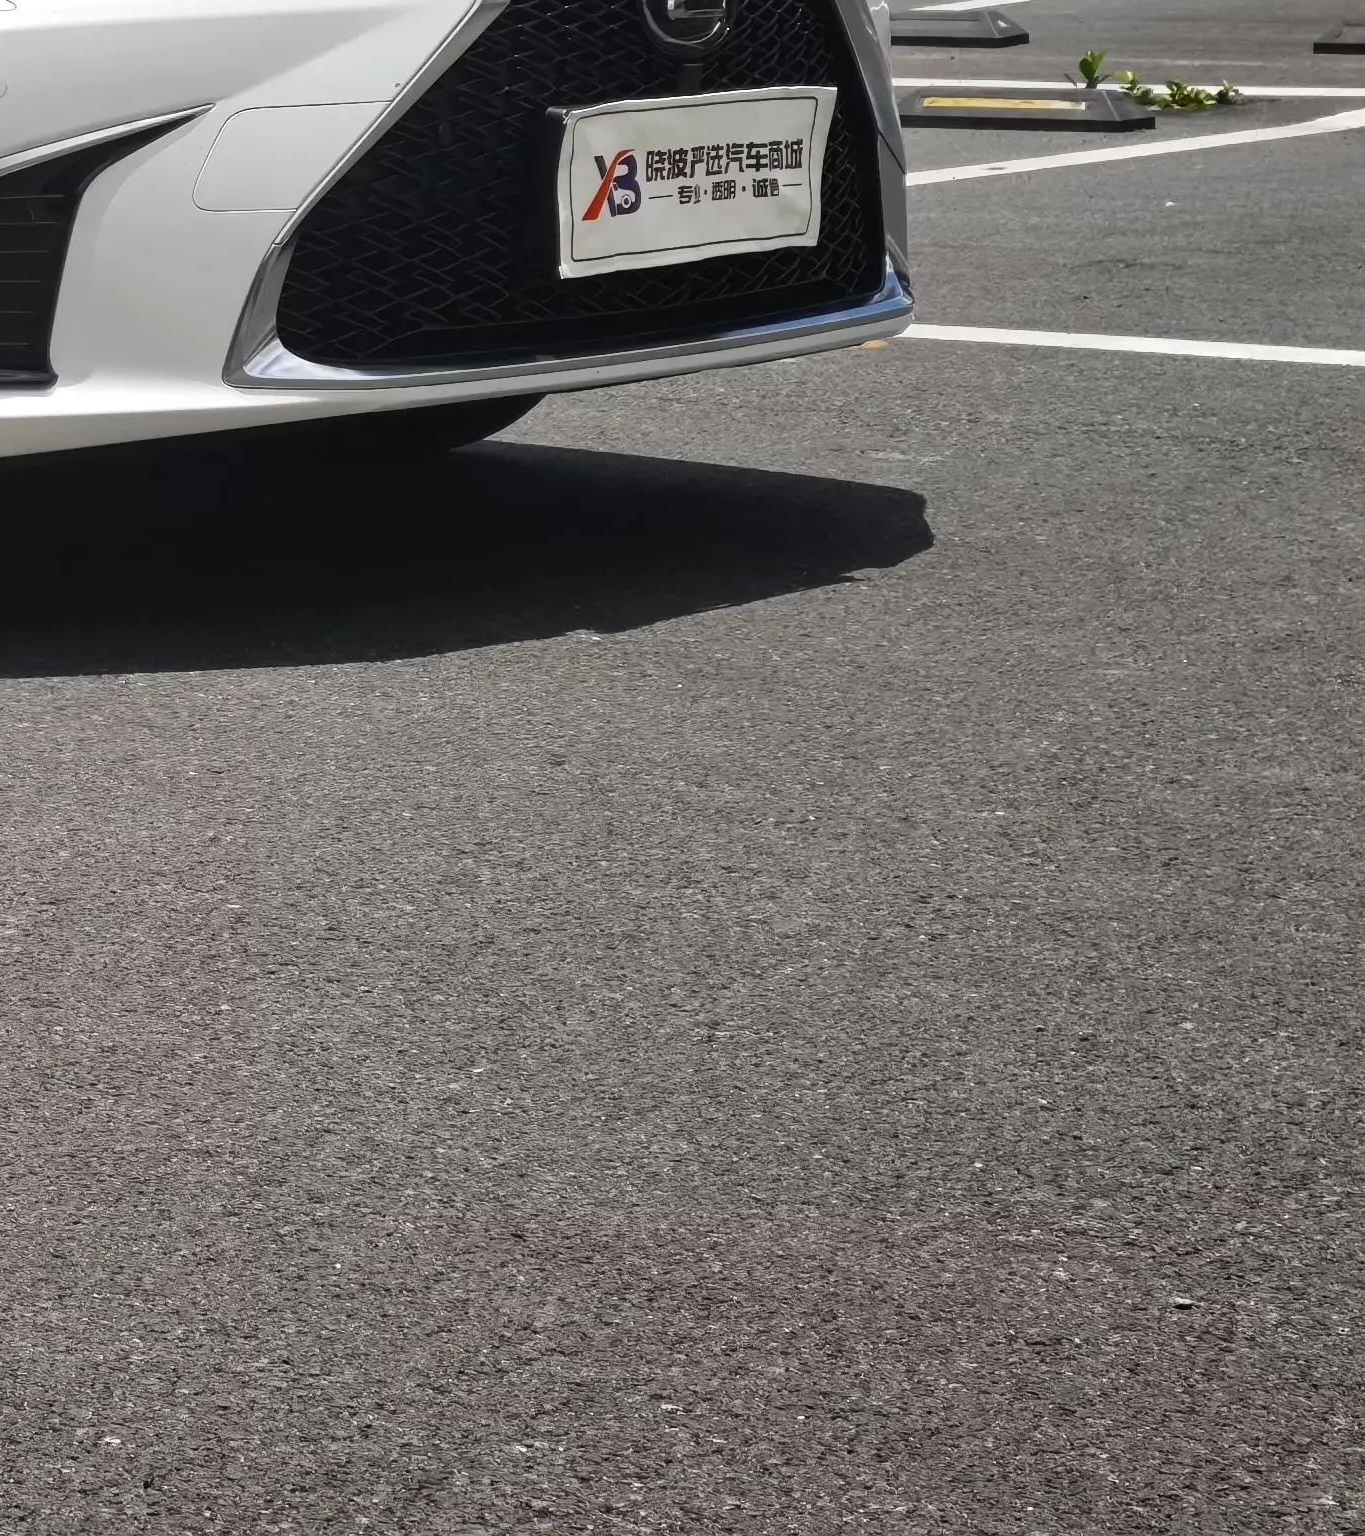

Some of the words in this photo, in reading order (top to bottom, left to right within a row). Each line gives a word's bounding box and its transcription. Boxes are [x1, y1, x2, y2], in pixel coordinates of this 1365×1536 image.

[645, 138, 804, 182] 晓波严选汽车商城
